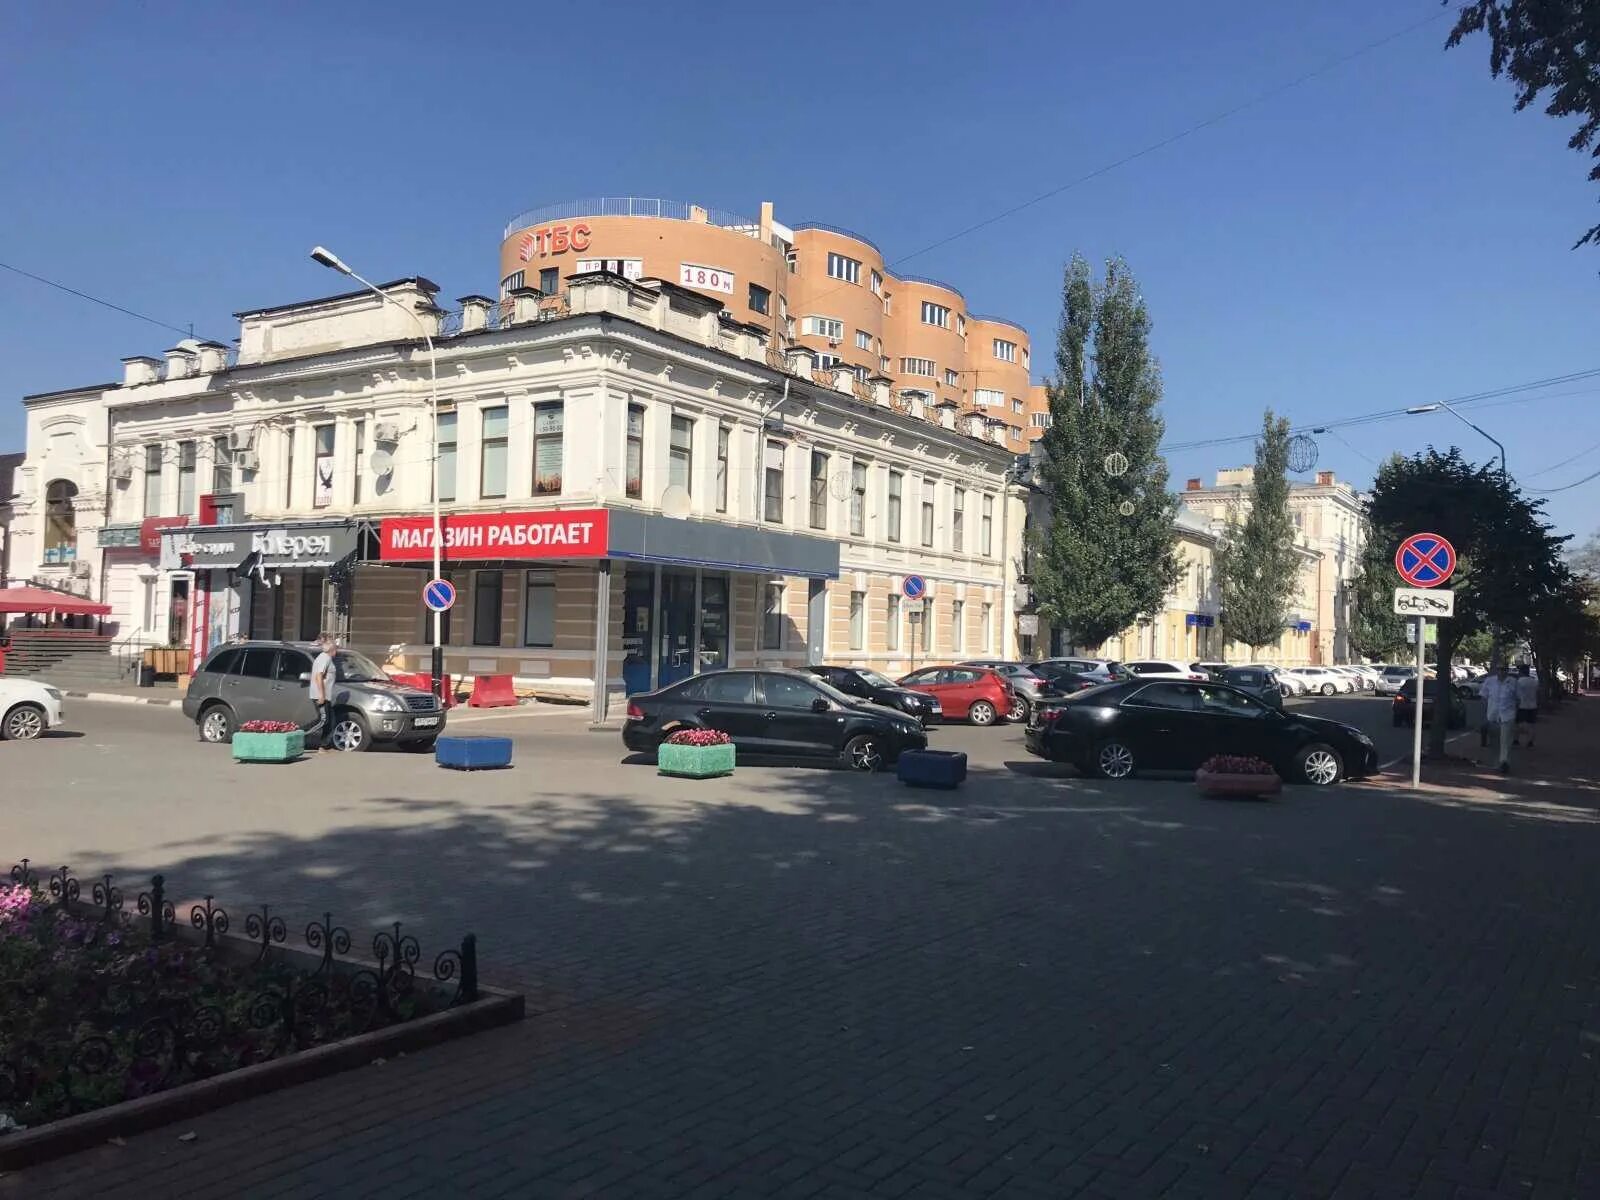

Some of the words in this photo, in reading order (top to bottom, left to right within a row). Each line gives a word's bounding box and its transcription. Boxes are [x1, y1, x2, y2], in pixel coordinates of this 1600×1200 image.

[536, 223, 590, 256] ТБС
[684, 268, 720, 288] 180
[391, 528, 482, 549] МАГАЗИН
[488, 522, 594, 546] РАБОТАЕТ
